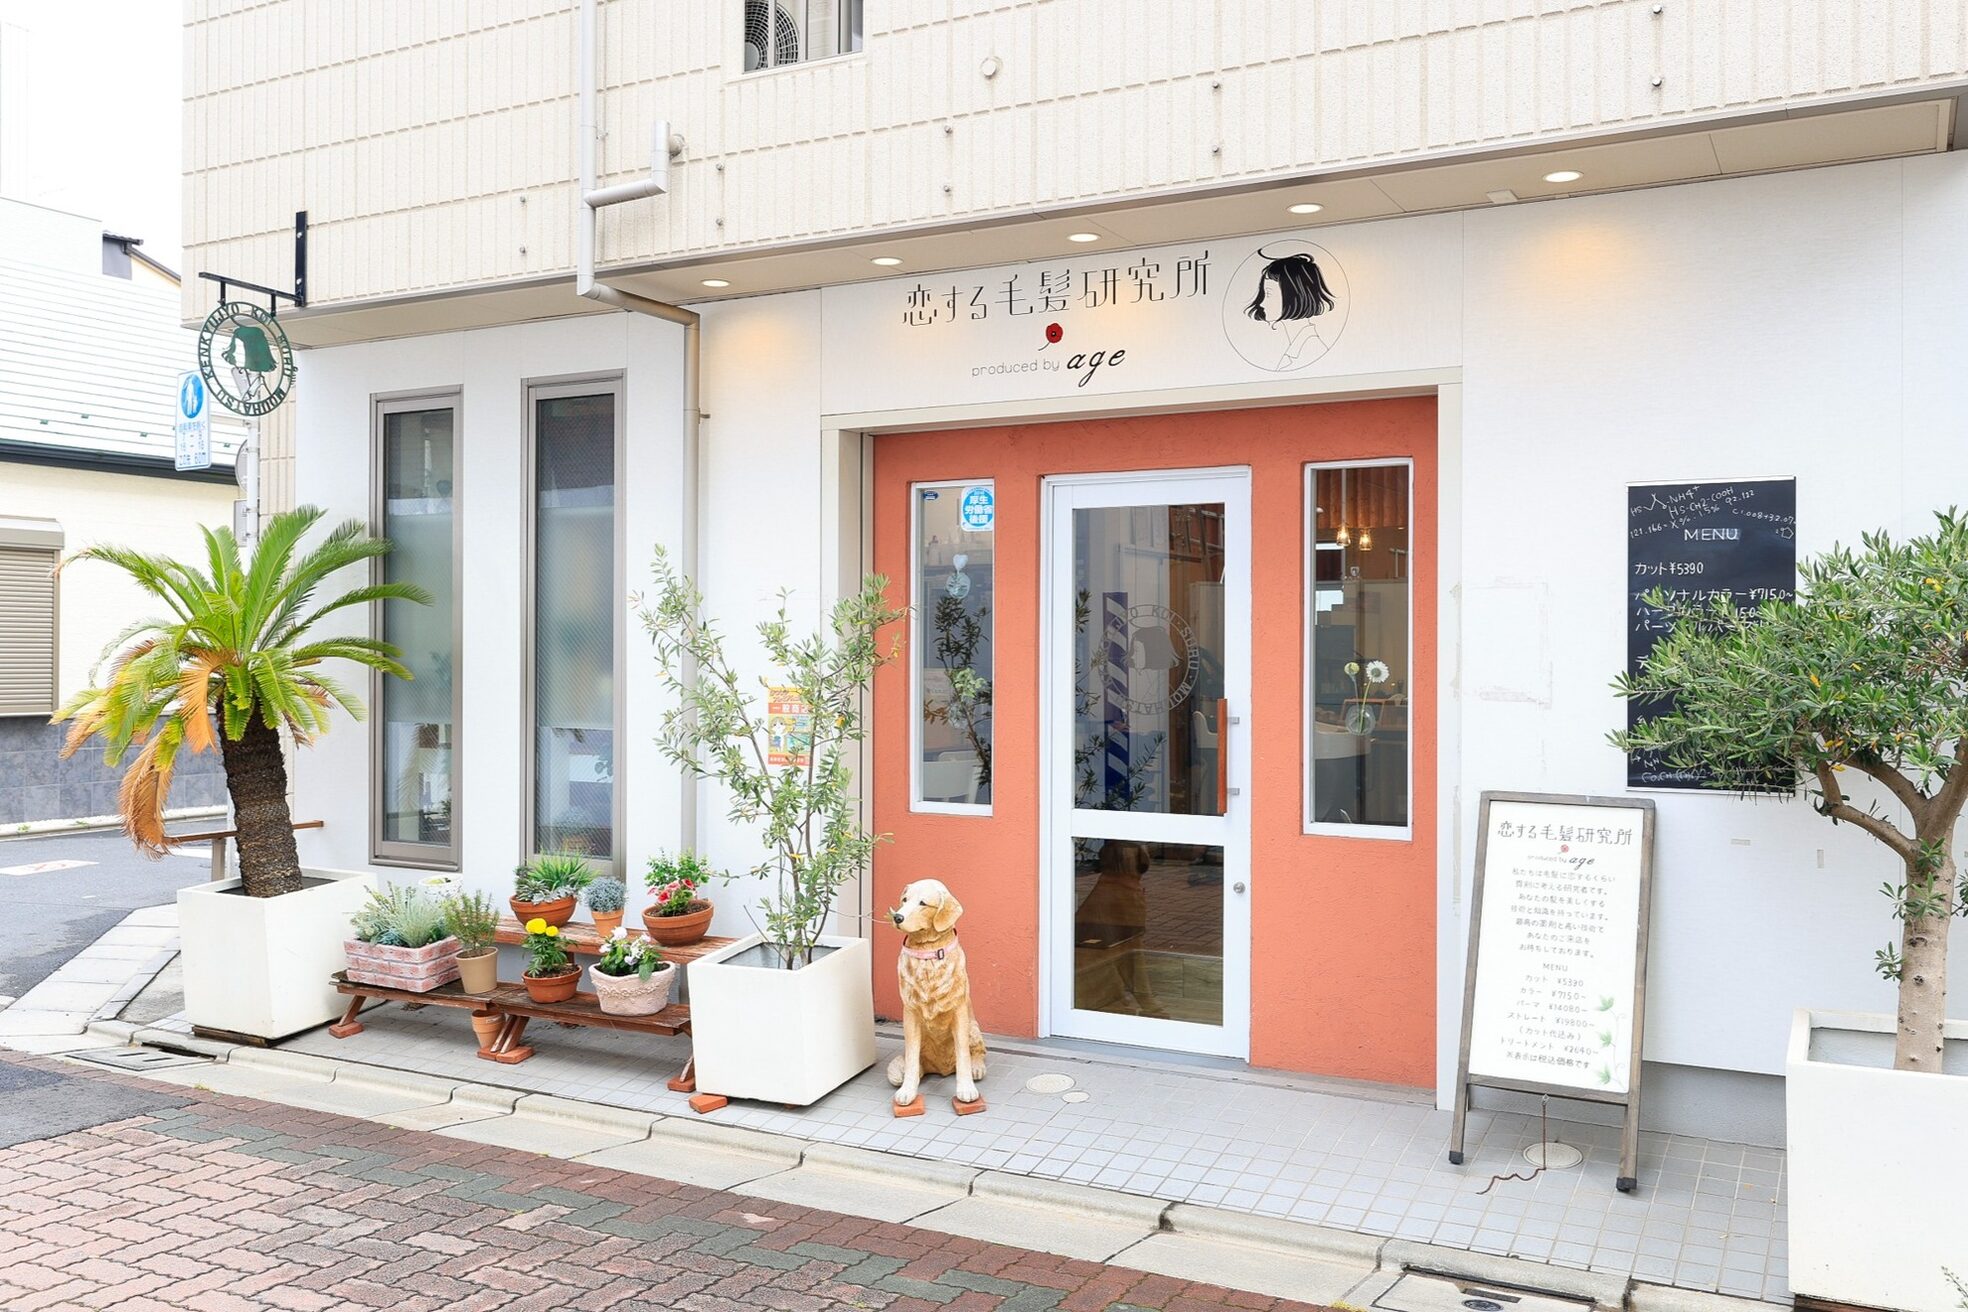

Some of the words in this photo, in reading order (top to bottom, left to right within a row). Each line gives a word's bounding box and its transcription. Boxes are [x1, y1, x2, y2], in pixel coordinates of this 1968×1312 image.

[902, 250, 1212, 327] 恋する毛髪研究所
[971, 359, 1038, 377] produced
[1043, 358, 1060, 372] by
[1066, 349, 1126, 388] age
[1684, 528, 1740, 541] MENU
[1497, 820, 1633, 847] 恋する毛髪研究所
[1569, 857, 1596, 871] age
[1542, 963, 1569, 972] MENU
